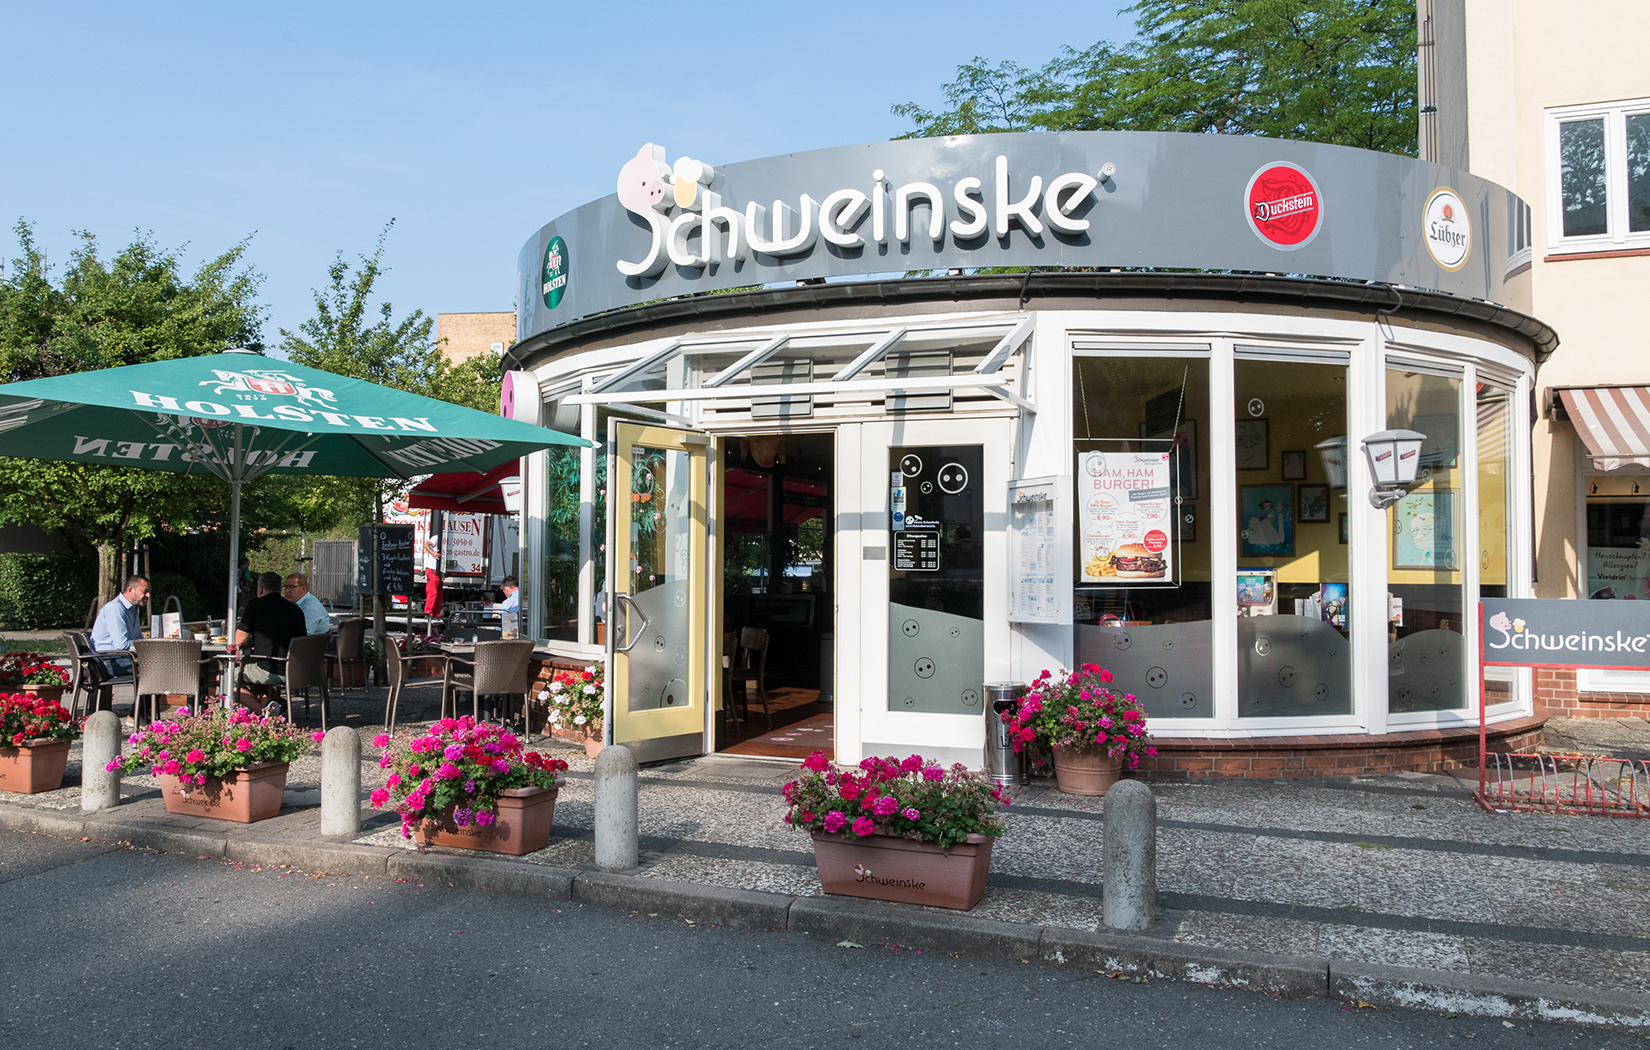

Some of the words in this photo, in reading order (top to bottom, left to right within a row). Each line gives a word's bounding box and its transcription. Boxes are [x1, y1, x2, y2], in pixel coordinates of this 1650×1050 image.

[1255, 194, 1313, 222] Duckstein
[1430, 221, 1467, 248] Lübzer
[543, 273, 567, 295] HOLSTEN
[129, 390, 439, 432] HOLSTEN
[1127, 468, 1154, 478] HAM
[1093, 479, 1154, 490] BURGER!
[1594, 551, 1647, 561] Heuschnupfen?
[470, 563, 481, 573] 34
[1602, 561, 1639, 572] Allergien?
[855, 873, 927, 891] Schweinske
